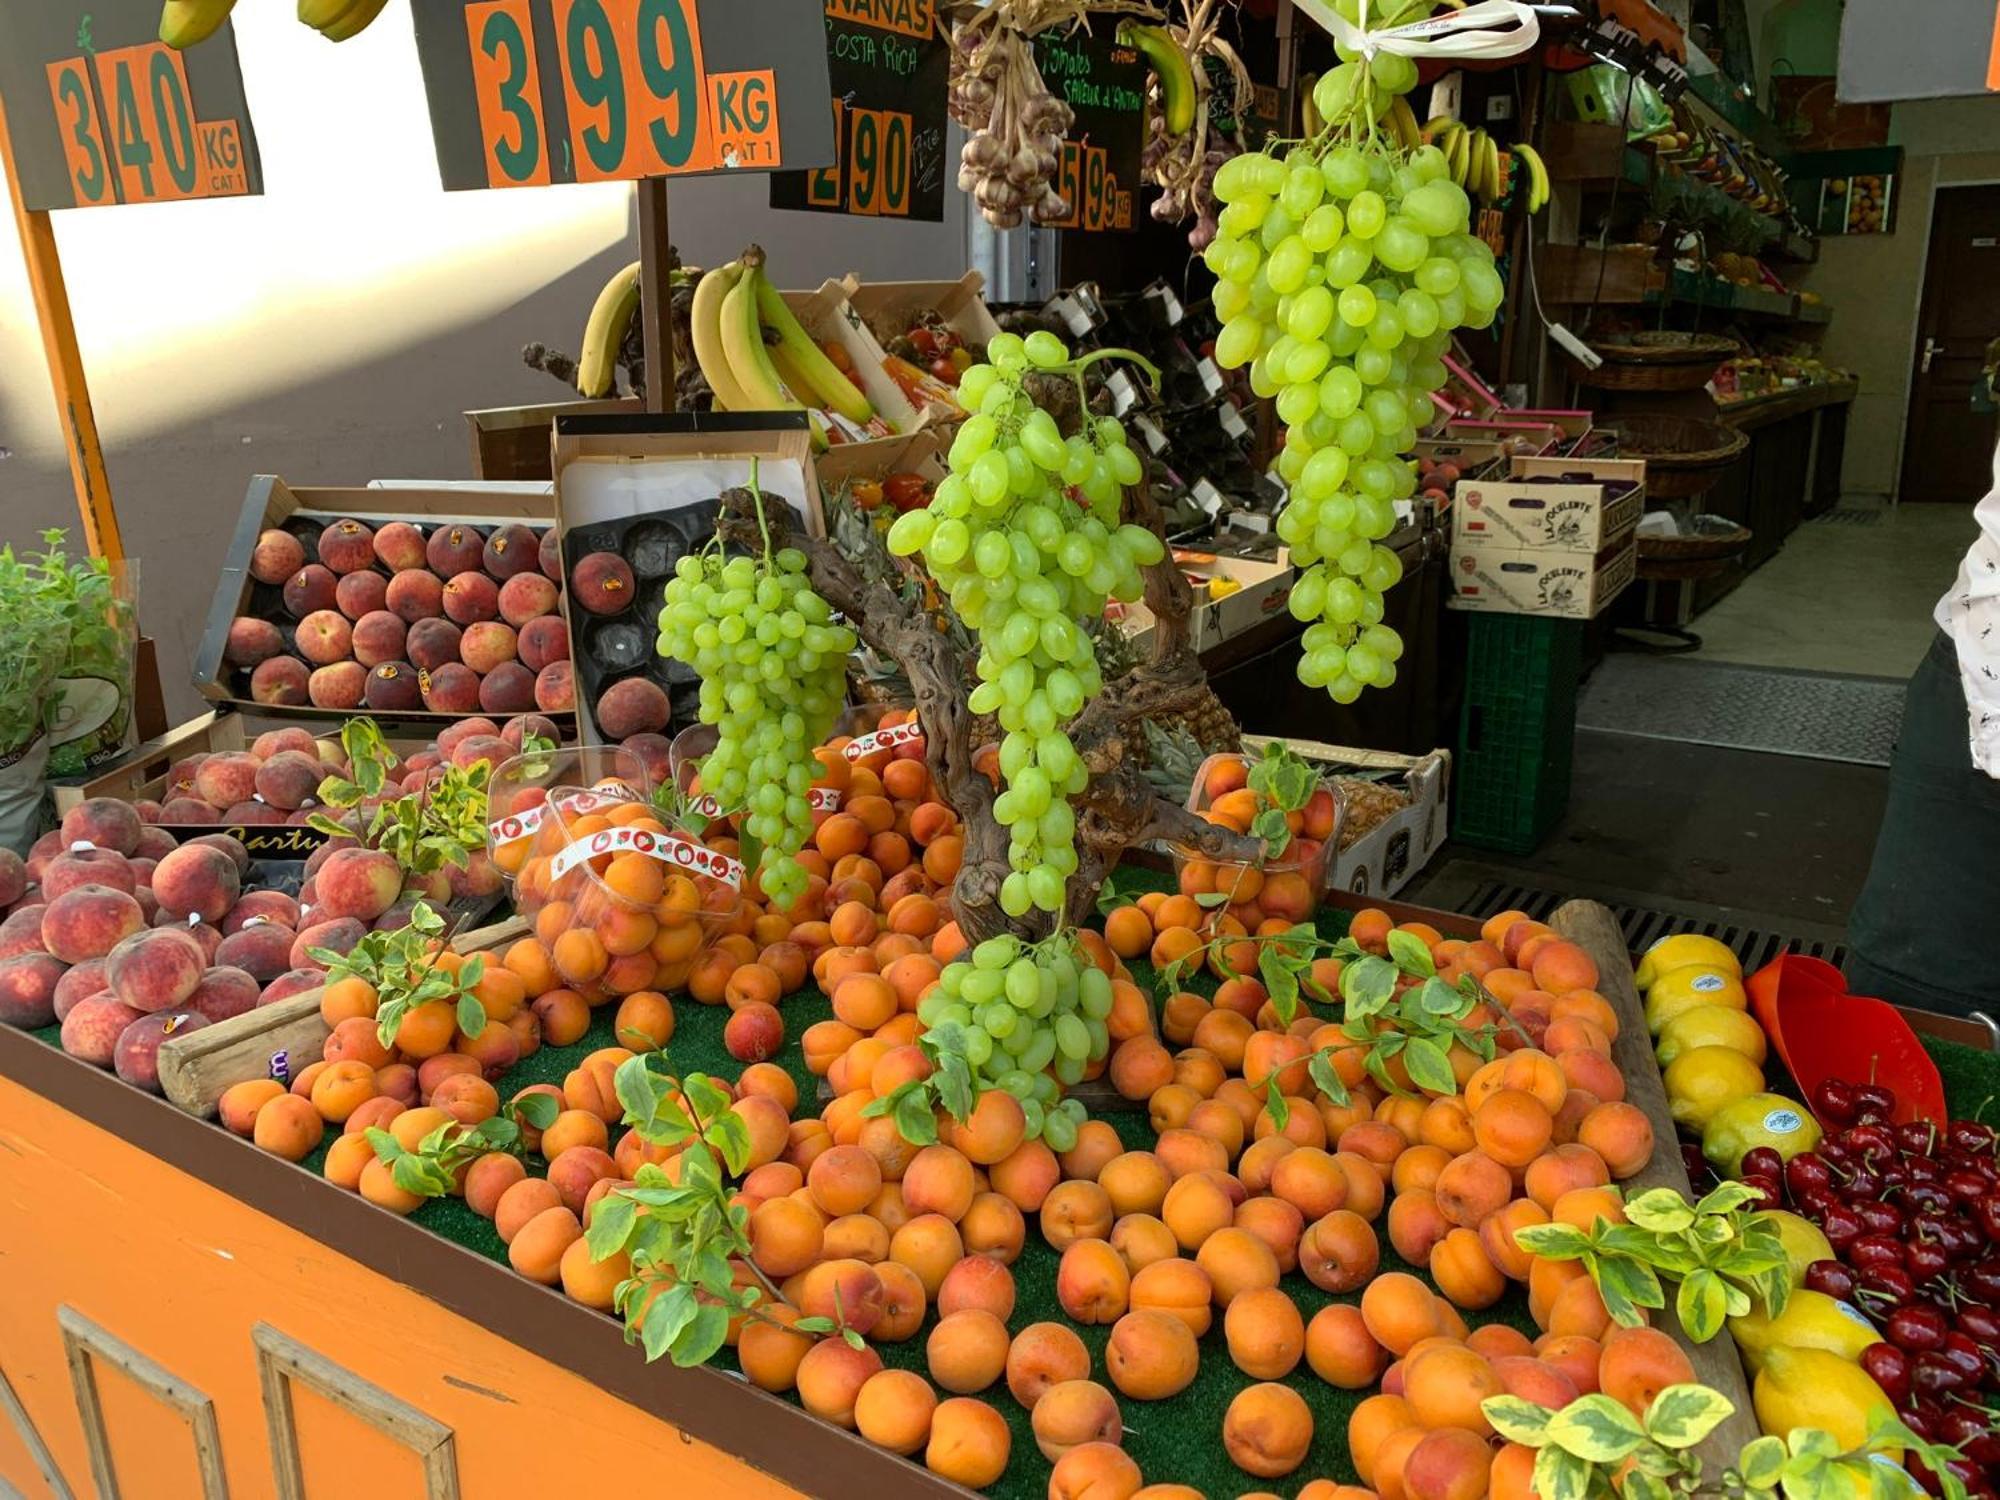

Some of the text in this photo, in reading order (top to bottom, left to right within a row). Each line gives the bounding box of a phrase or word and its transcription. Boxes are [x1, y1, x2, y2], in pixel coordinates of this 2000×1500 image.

[826, 20, 877, 68] OSTA
[716, 77, 769, 134] KG
[203, 126, 238, 169] KG
[764, 141, 772, 160] 1
[211, 174, 245, 191] CAT 1
